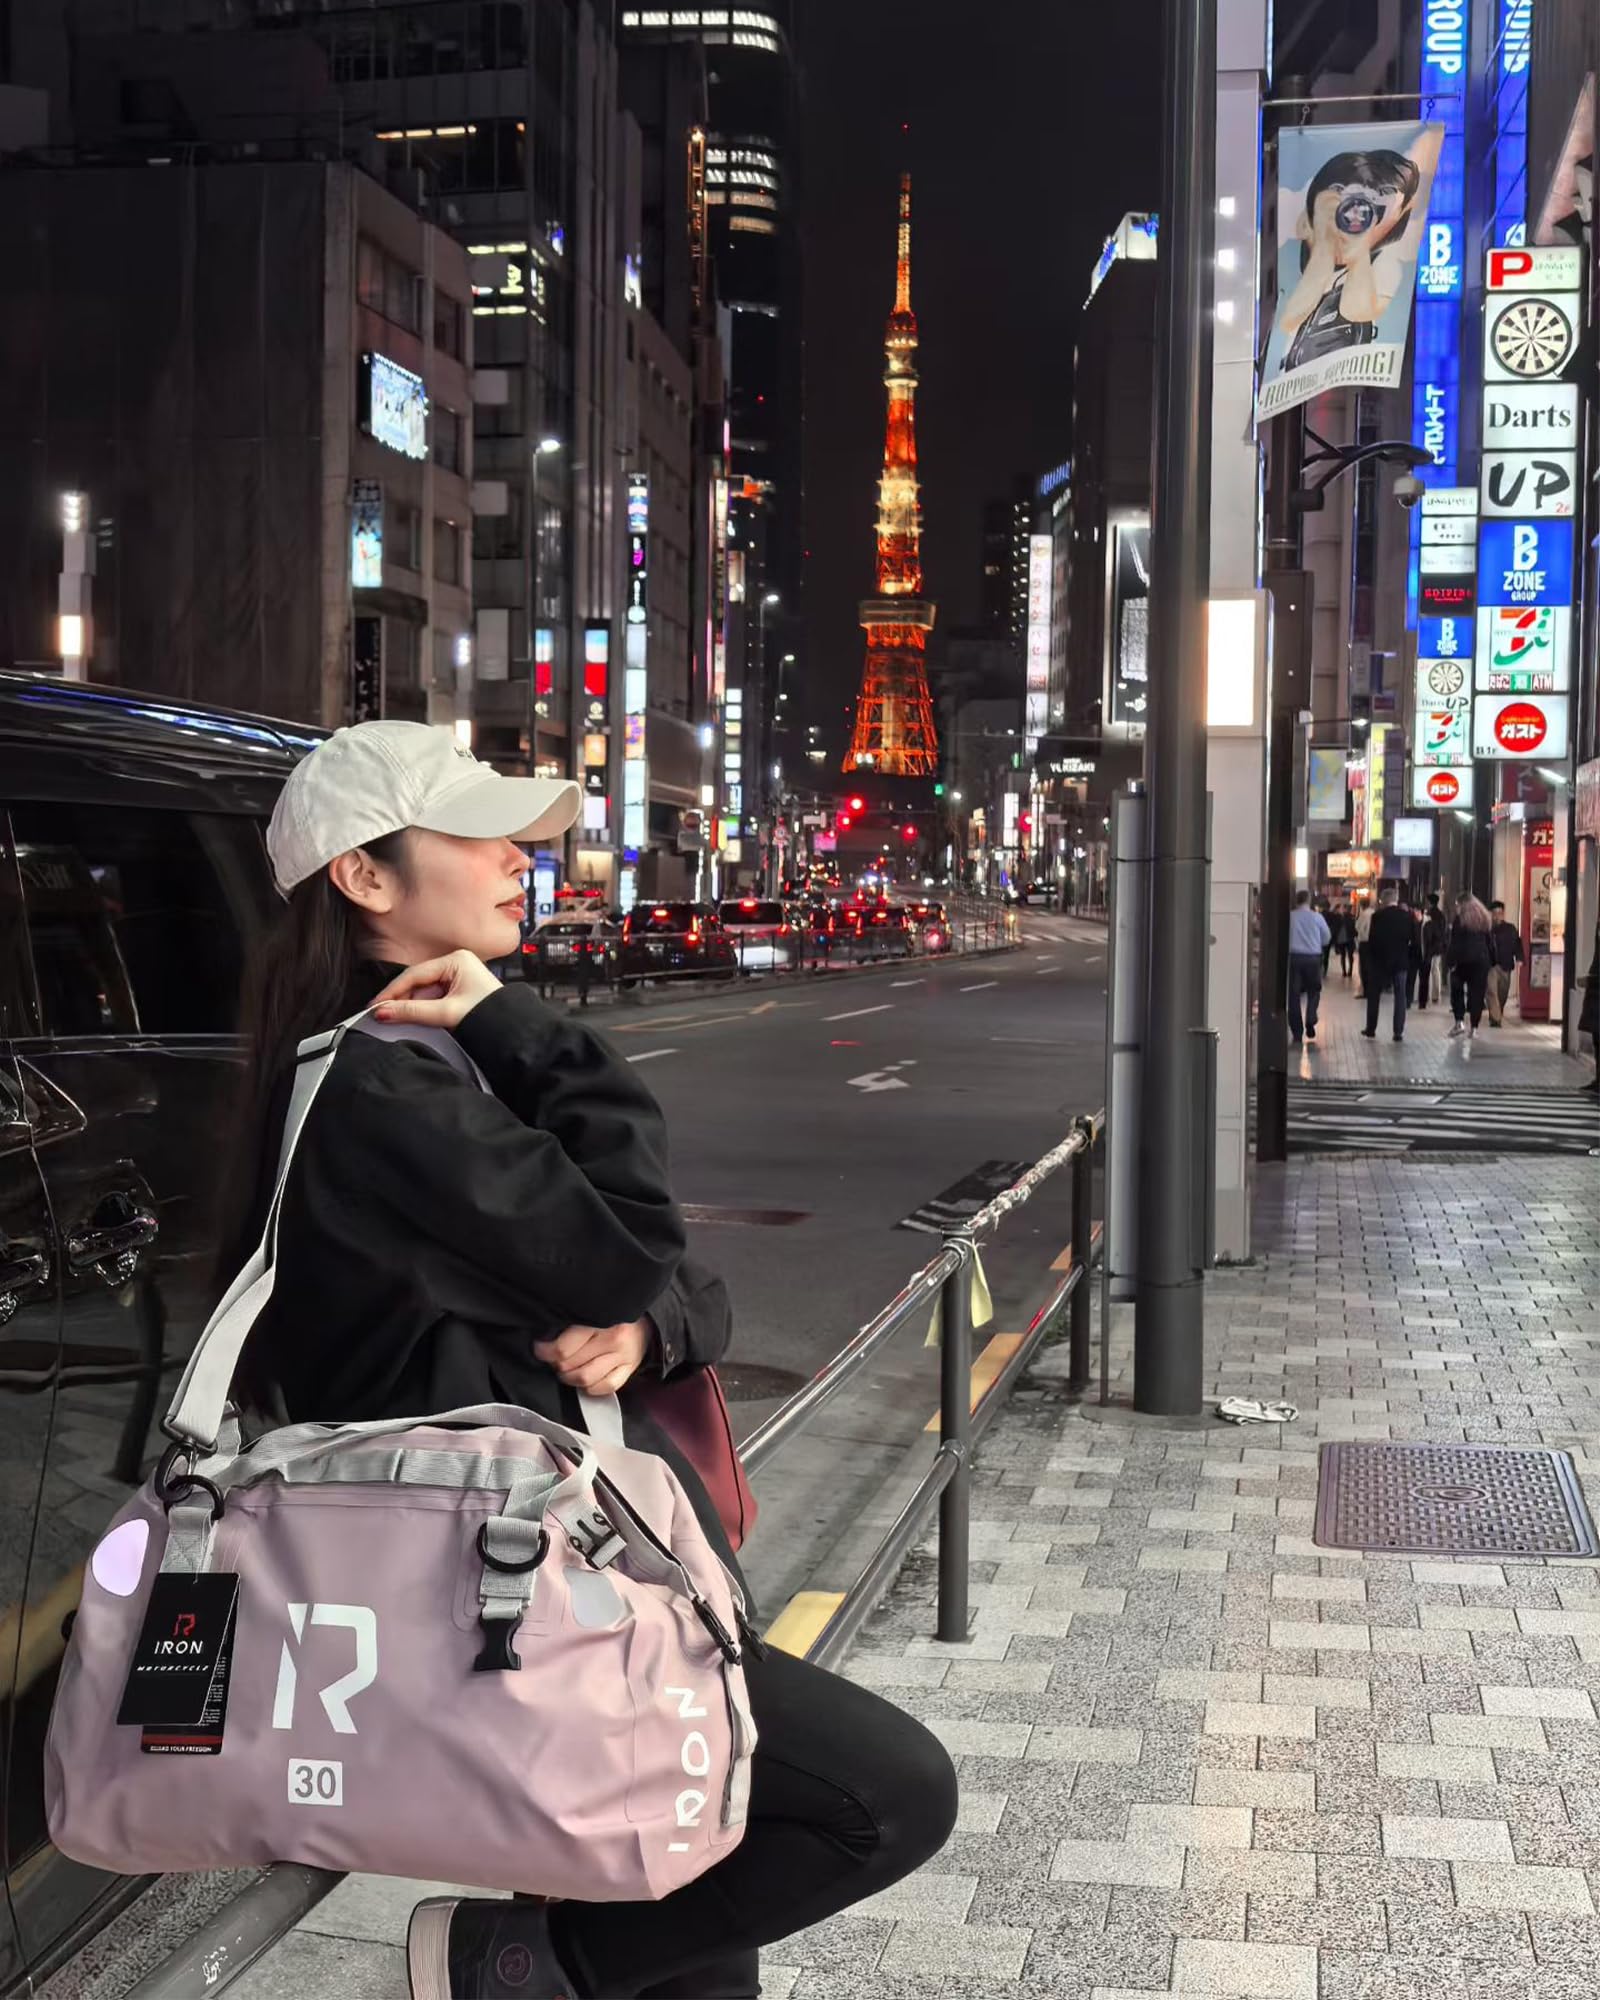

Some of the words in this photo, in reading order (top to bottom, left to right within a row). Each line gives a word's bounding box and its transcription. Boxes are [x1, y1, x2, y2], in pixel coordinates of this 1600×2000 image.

[1420, 264, 1459, 285] ZONE
[1490, 251, 1533, 287] P
[1488, 402, 1572, 428] Darts
[1488, 460, 1571, 509] UP
[1513, 525, 1538, 570] B
[1503, 571, 1546, 591] ZONE
[1511, 591, 1537, 601] GROUP
[1533, 674, 1553, 691] ATM
[1501, 723, 1543, 739] ガスト
[153, 1640, 203, 1655] IRON
[664, 1686, 710, 1852] IRON
[294, 1765, 337, 1799] 30
